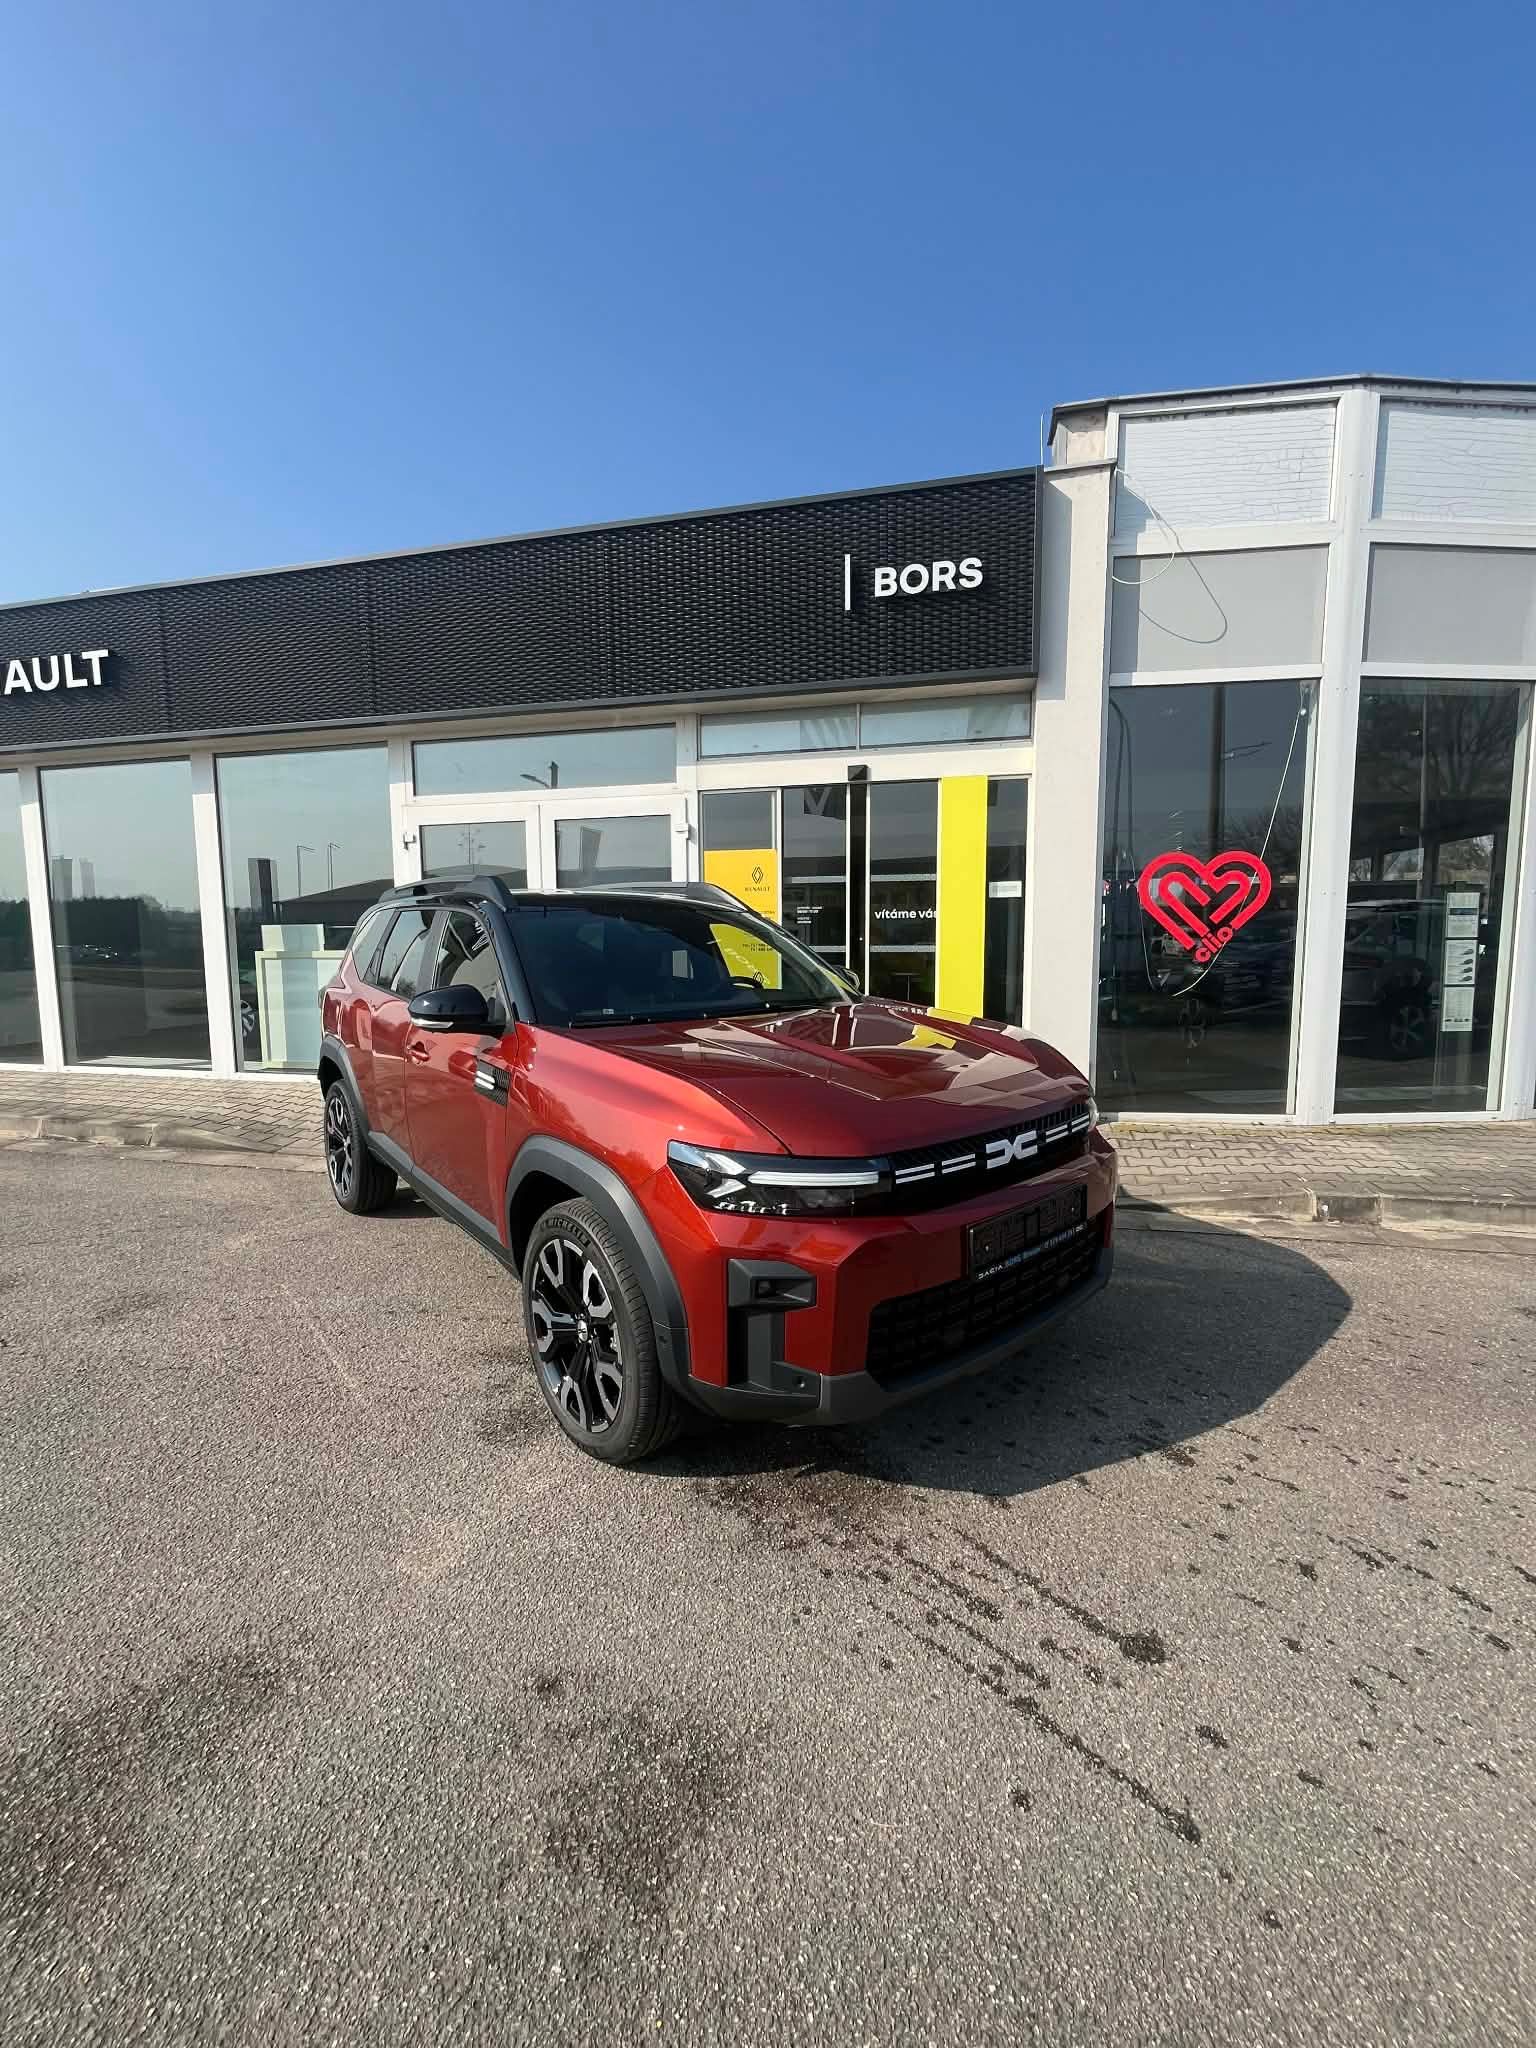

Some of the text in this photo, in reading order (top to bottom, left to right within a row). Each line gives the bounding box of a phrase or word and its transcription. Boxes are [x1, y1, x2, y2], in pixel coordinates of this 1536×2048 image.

[874, 557, 984, 598] BORS
[3, 649, 109, 695] AULT
[874, 908, 917, 920] vítáme
[1195, 926, 1233, 963] clio
[546, 1217, 591, 1249] MICHELIN
